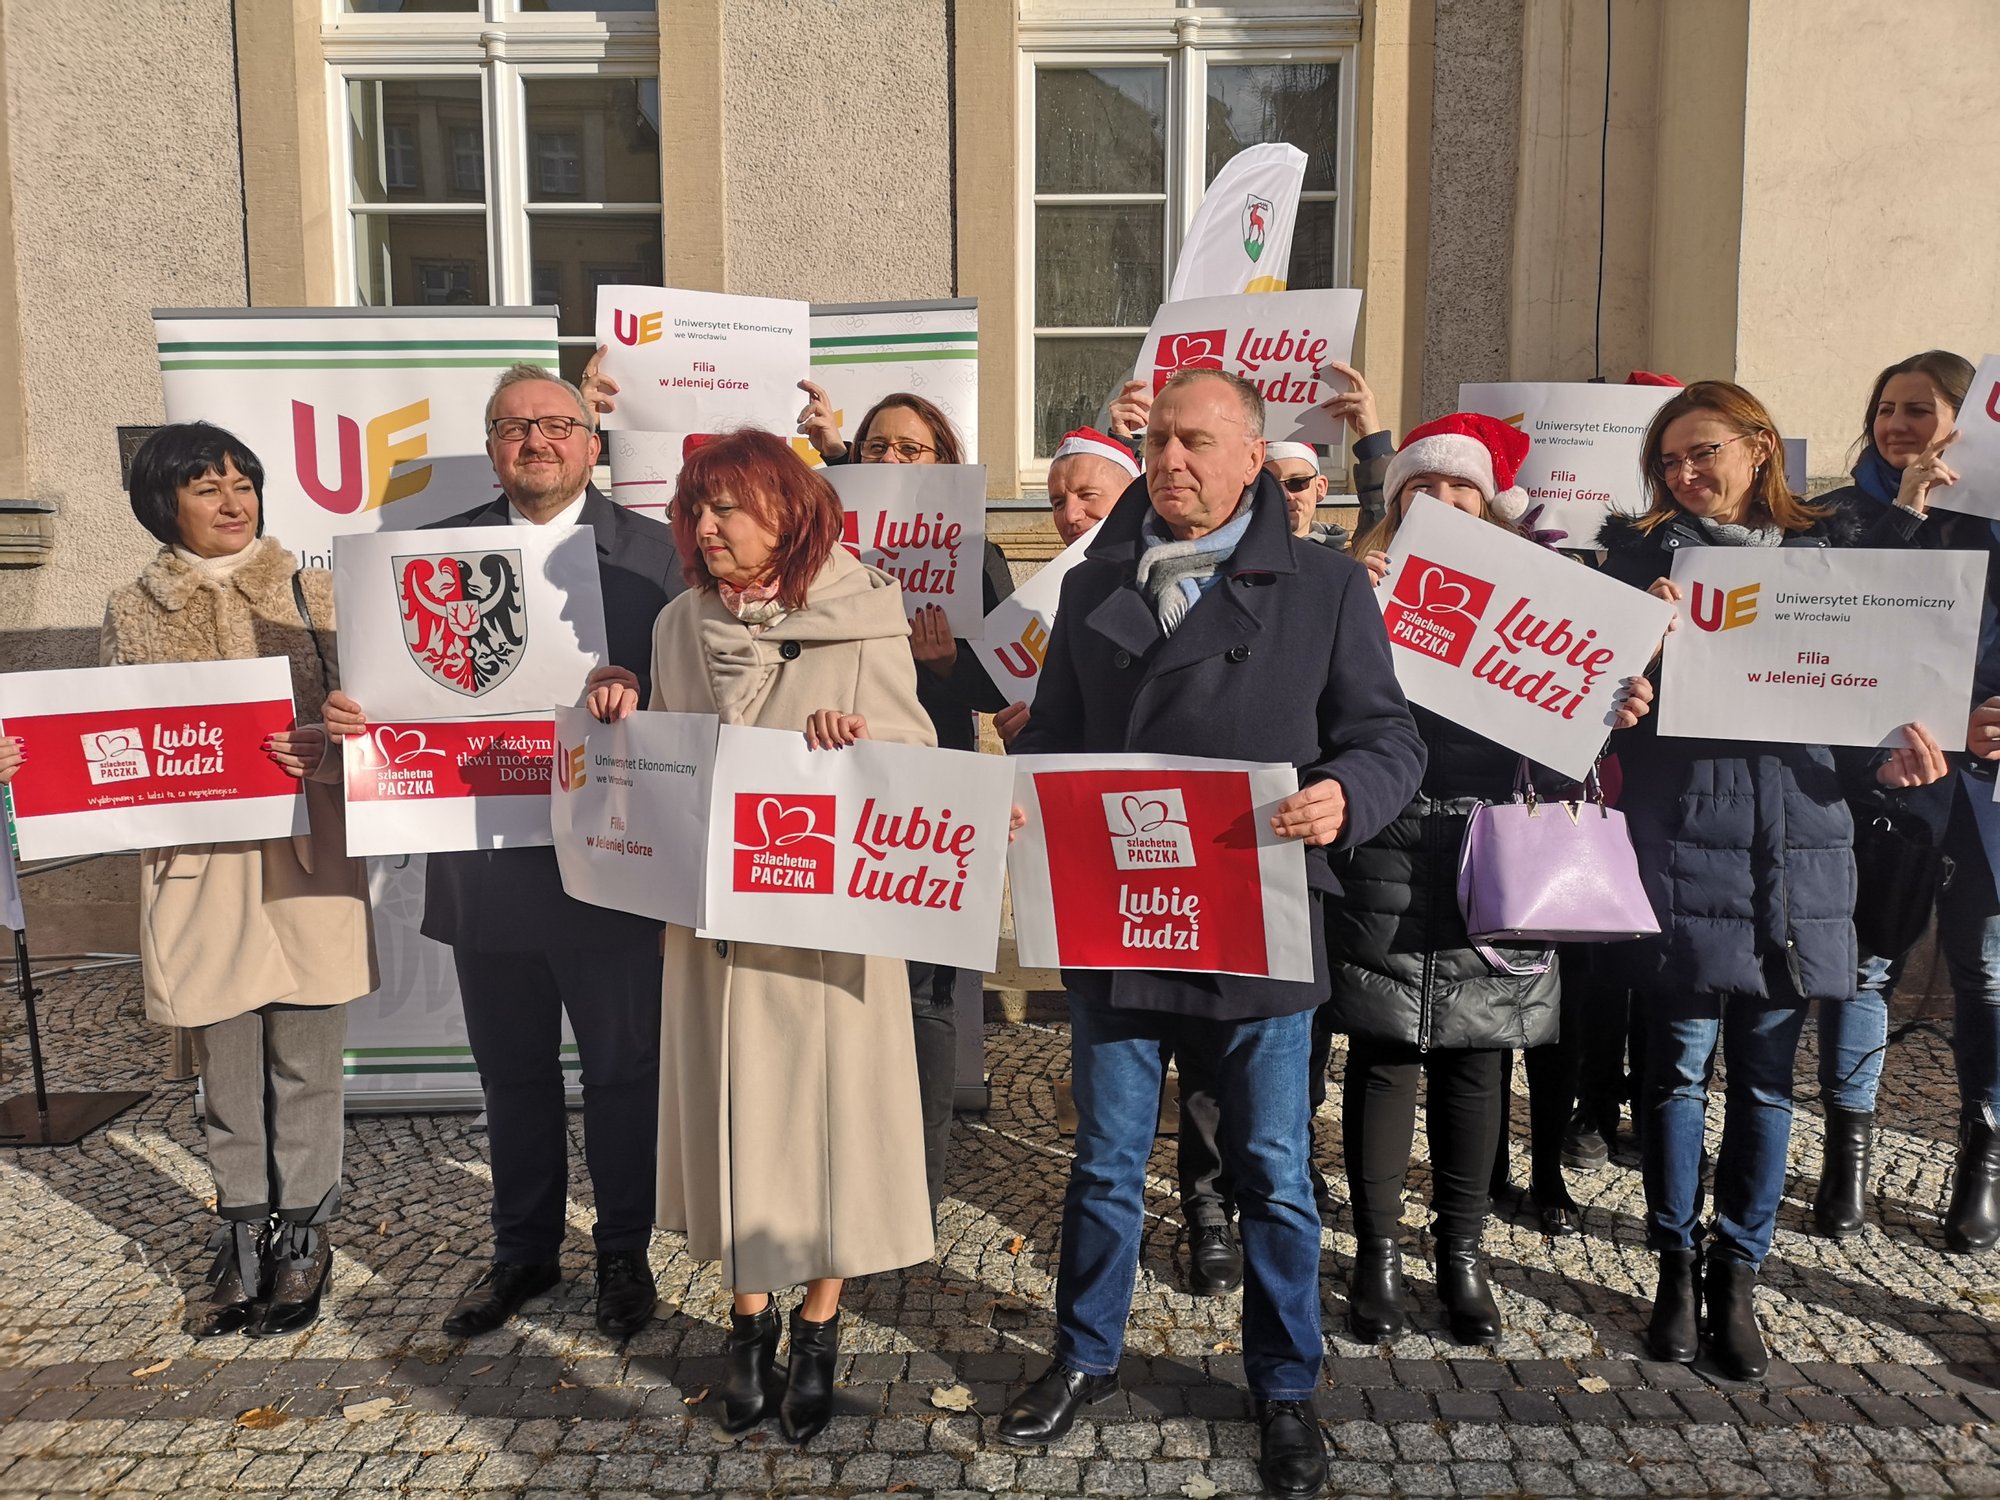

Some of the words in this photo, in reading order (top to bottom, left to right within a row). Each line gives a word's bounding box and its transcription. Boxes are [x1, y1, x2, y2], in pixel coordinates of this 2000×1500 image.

[614, 308, 663, 346] UE
[674, 318, 731, 330] Uniwersytet
[733, 322, 793, 335] Ekonomiczny
[687, 331, 727, 341] Wrocławiu
[1235, 328, 1327, 372] Lubię
[693, 362, 716, 372] Filia
[659, 378, 669, 387] w
[672, 377, 714, 390] Jeleniej
[717, 378, 749, 390] Górze
[1535, 421, 1600, 433] Uniwersytet
[1602, 422, 1648, 435] Ekonomi
[1549, 437, 1594, 446] Wrocławiu
[291, 398, 433, 515] UE
[1550, 471, 1576, 482] Filia
[1575, 489, 1610, 501] Górze
[873, 510, 961, 560] Lubię
[1691, 581, 1760, 632] UE
[1775, 592, 1858, 607] Uniwersytet
[1862, 594, 1955, 611] Ekonomiczny
[1774, 612, 1790, 620] we
[1793, 611, 1851, 622] Wrocławiu
[1401, 610, 1456, 641] szlachetna
[1393, 620, 1450, 657] PACZKA
[1493, 597, 1614, 685] Lubię
[1797, 651, 1830, 665] Filia
[1472, 645, 1591, 720] ludzi
[1747, 673, 1760, 682] w
[1764, 671, 1826, 688] Jeleniej
[1830, 674, 1878, 687] Górze
[153, 721, 224, 756] Lubię
[467, 737, 485, 750] W
[489, 736, 552, 753] każdym
[156, 751, 224, 777] ludzi
[456, 752, 492, 766] tkwi
[496, 755, 530, 765] moc
[558, 740, 587, 793] UE
[595, 755, 636, 770] Uniwersytet
[638, 758, 697, 777] Ekonomiczny
[101, 767, 138, 778] PACZKA
[378, 769, 433, 780] szlachetna
[500, 767, 550, 782] DOBR
[596, 775, 607, 784] we
[378, 780, 435, 796] PACZKA
[610, 816, 625, 831] Filia
[853, 798, 976, 868] Lubię
[586, 836, 595, 846] w
[596, 835, 625, 855] Jeleniej
[627, 841, 653, 857] Górze
[1127, 838, 1177, 848] szlachetna
[753, 851, 817, 869] szlachetna
[1128, 849, 1180, 863] PACZKA
[750, 866, 815, 889] PACZKA
[847, 857, 967, 912] ludzi
[1118, 884, 1200, 924] Lubię
[1122, 921, 1200, 951] ludzi
